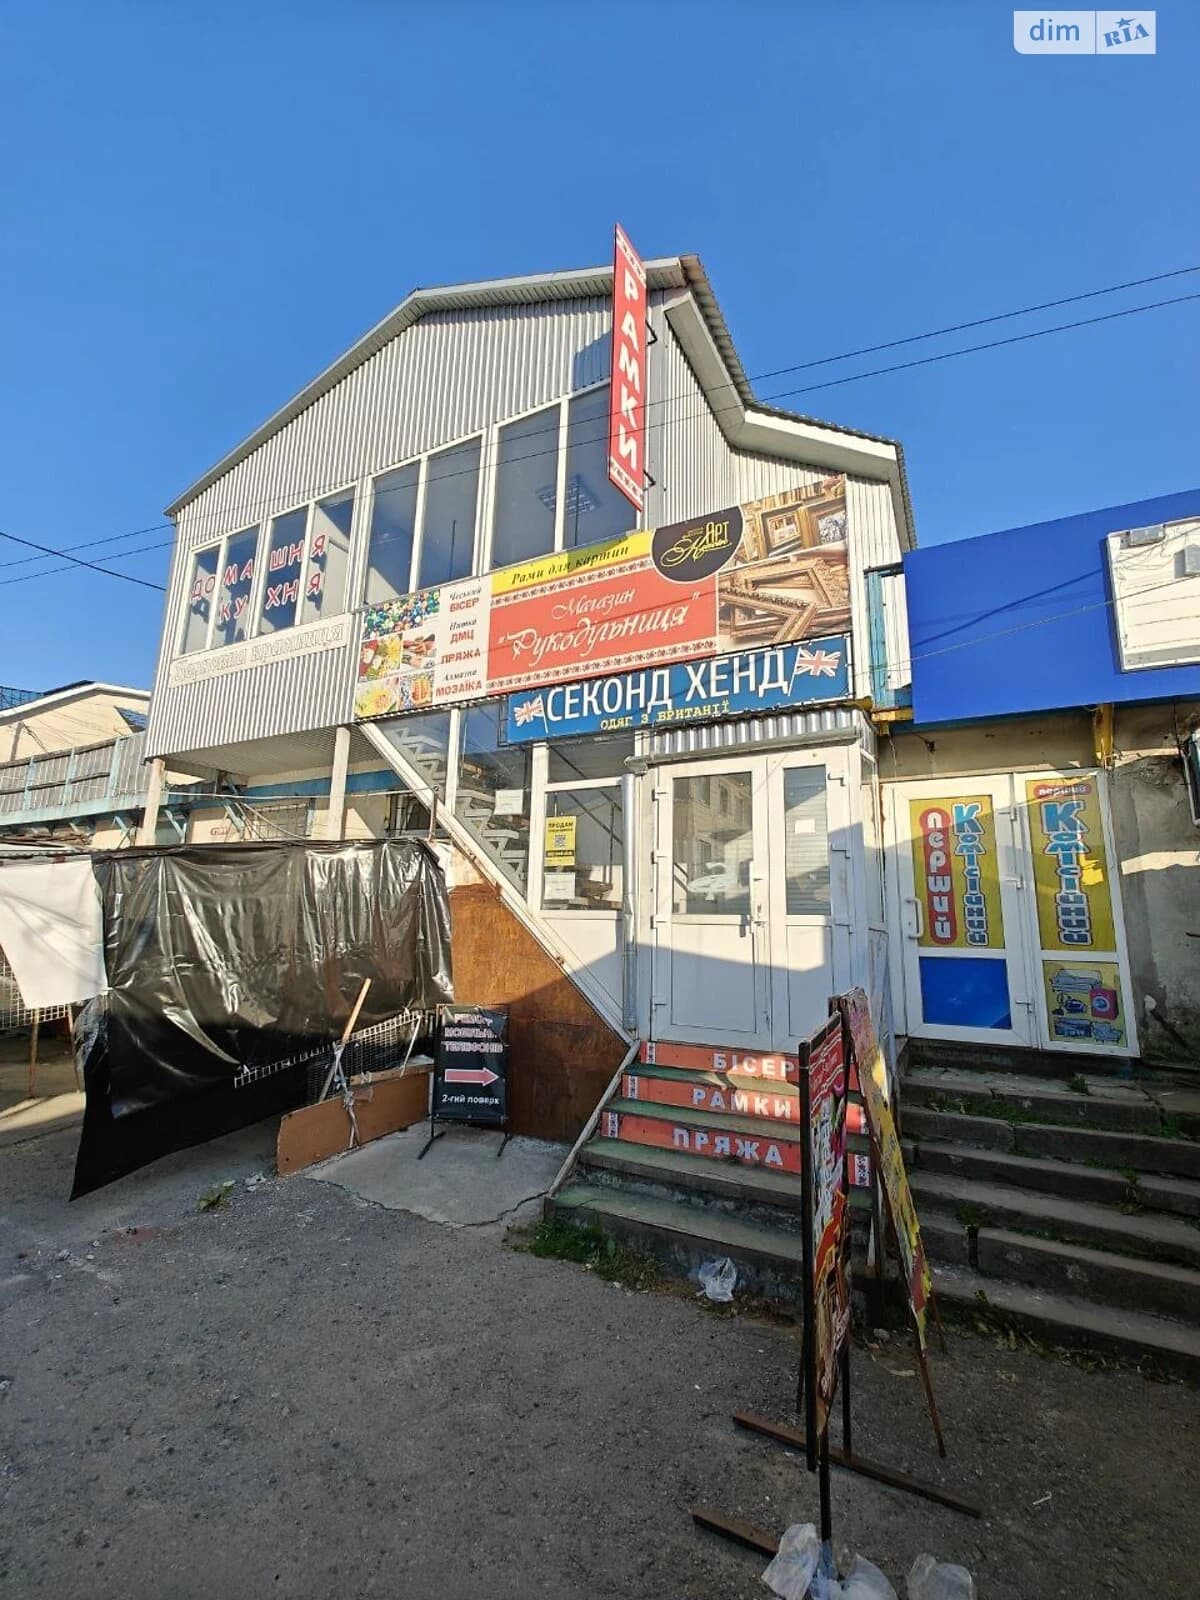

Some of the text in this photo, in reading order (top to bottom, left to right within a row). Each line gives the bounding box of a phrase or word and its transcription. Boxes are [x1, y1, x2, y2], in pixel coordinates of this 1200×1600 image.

[618, 267, 641, 470] РАМКИ
[192, 534, 326, 600] ДОМАШНЯ
[511, 546, 629, 585] Рами для картин
[219, 573, 321, 624] КУХНЯ
[449, 597, 480, 613] БІСЕР
[552, 588, 637, 619] Магазин
[450, 629, 475, 645] ДМЦ
[440, 648, 481, 665] ПРЯЖА
[436, 680, 482, 697] МОЗАЇКА
[547, 647, 790, 722] СЕКОНД ХЕНД
[713, 1052, 795, 1081] БІСЕР
[441, 1094, 500, 1106] 2-гий поверх
[692, 1086, 792, 1120] РАМКИ
[672, 1127, 784, 1167] ПРЯЖА
